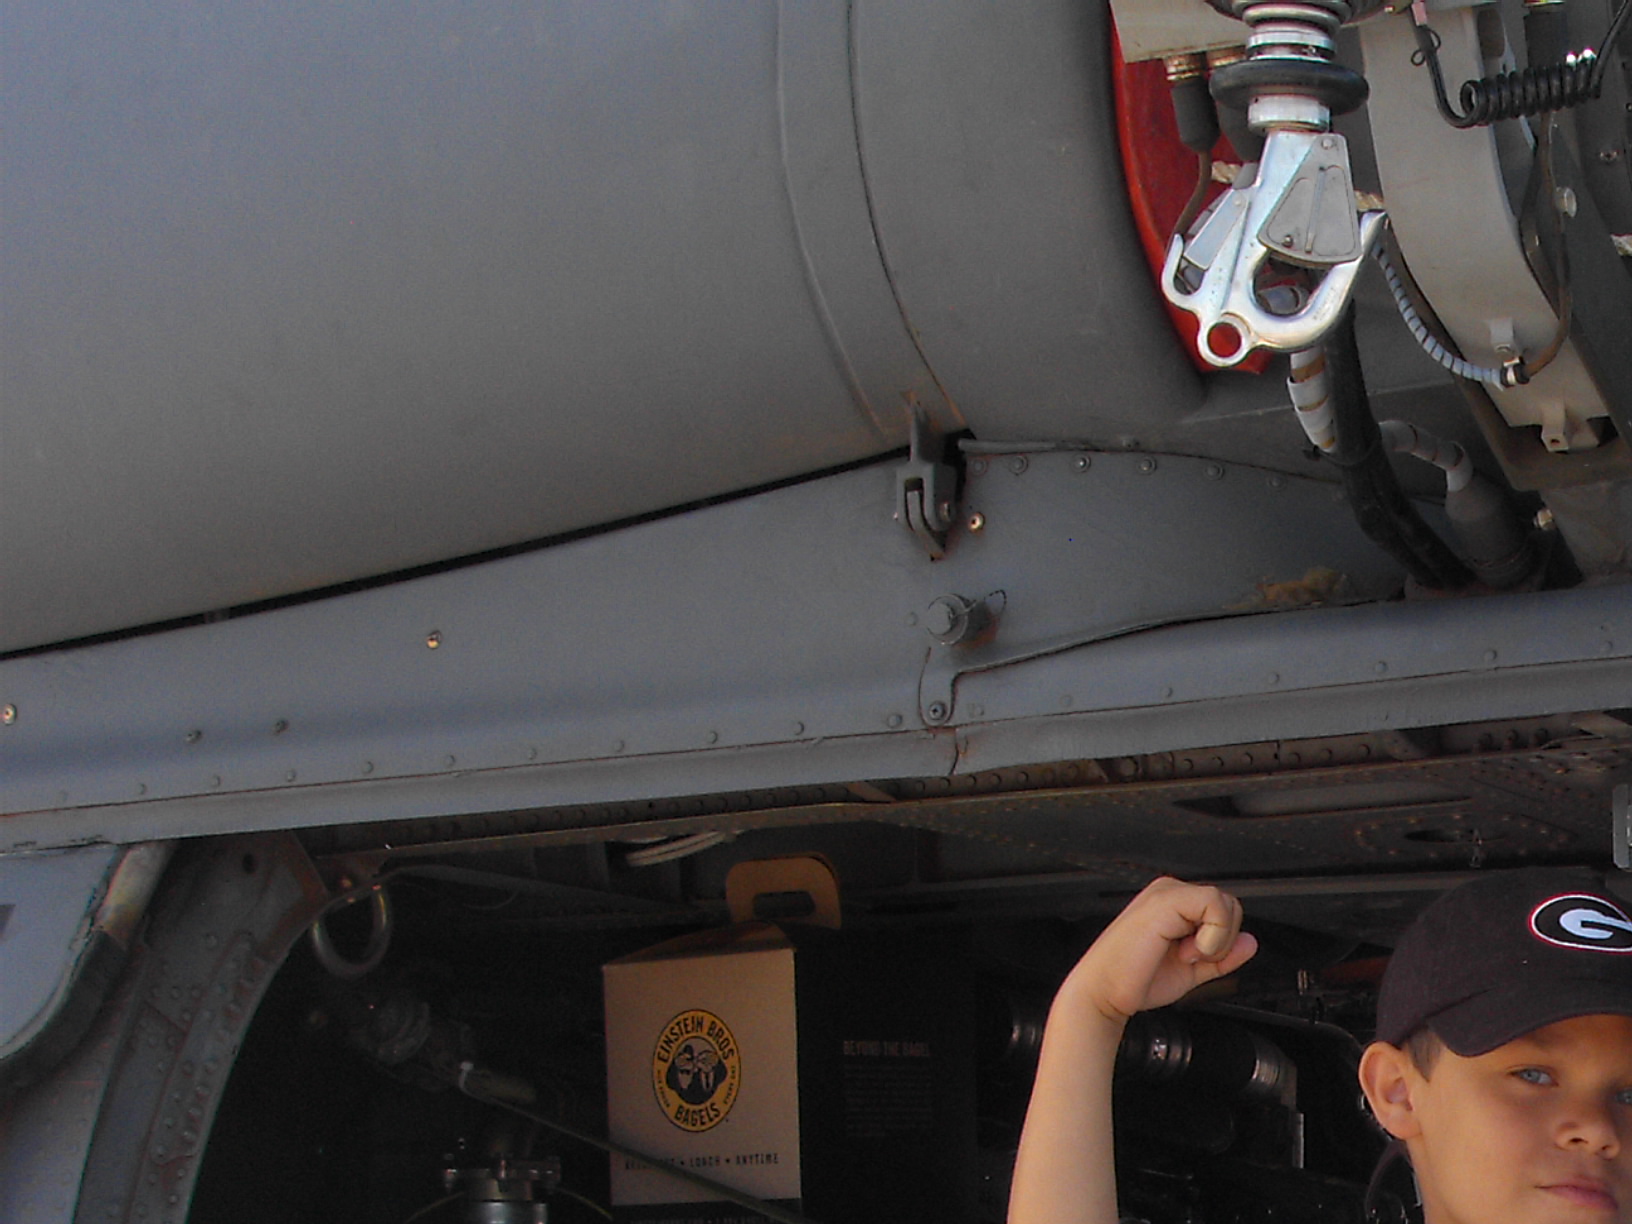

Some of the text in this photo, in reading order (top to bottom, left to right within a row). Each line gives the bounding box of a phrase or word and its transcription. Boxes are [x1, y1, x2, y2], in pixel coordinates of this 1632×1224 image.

[657, 1016, 735, 1063] EINSTEIN BROS
[674, 1102, 721, 1127] BAGELS
